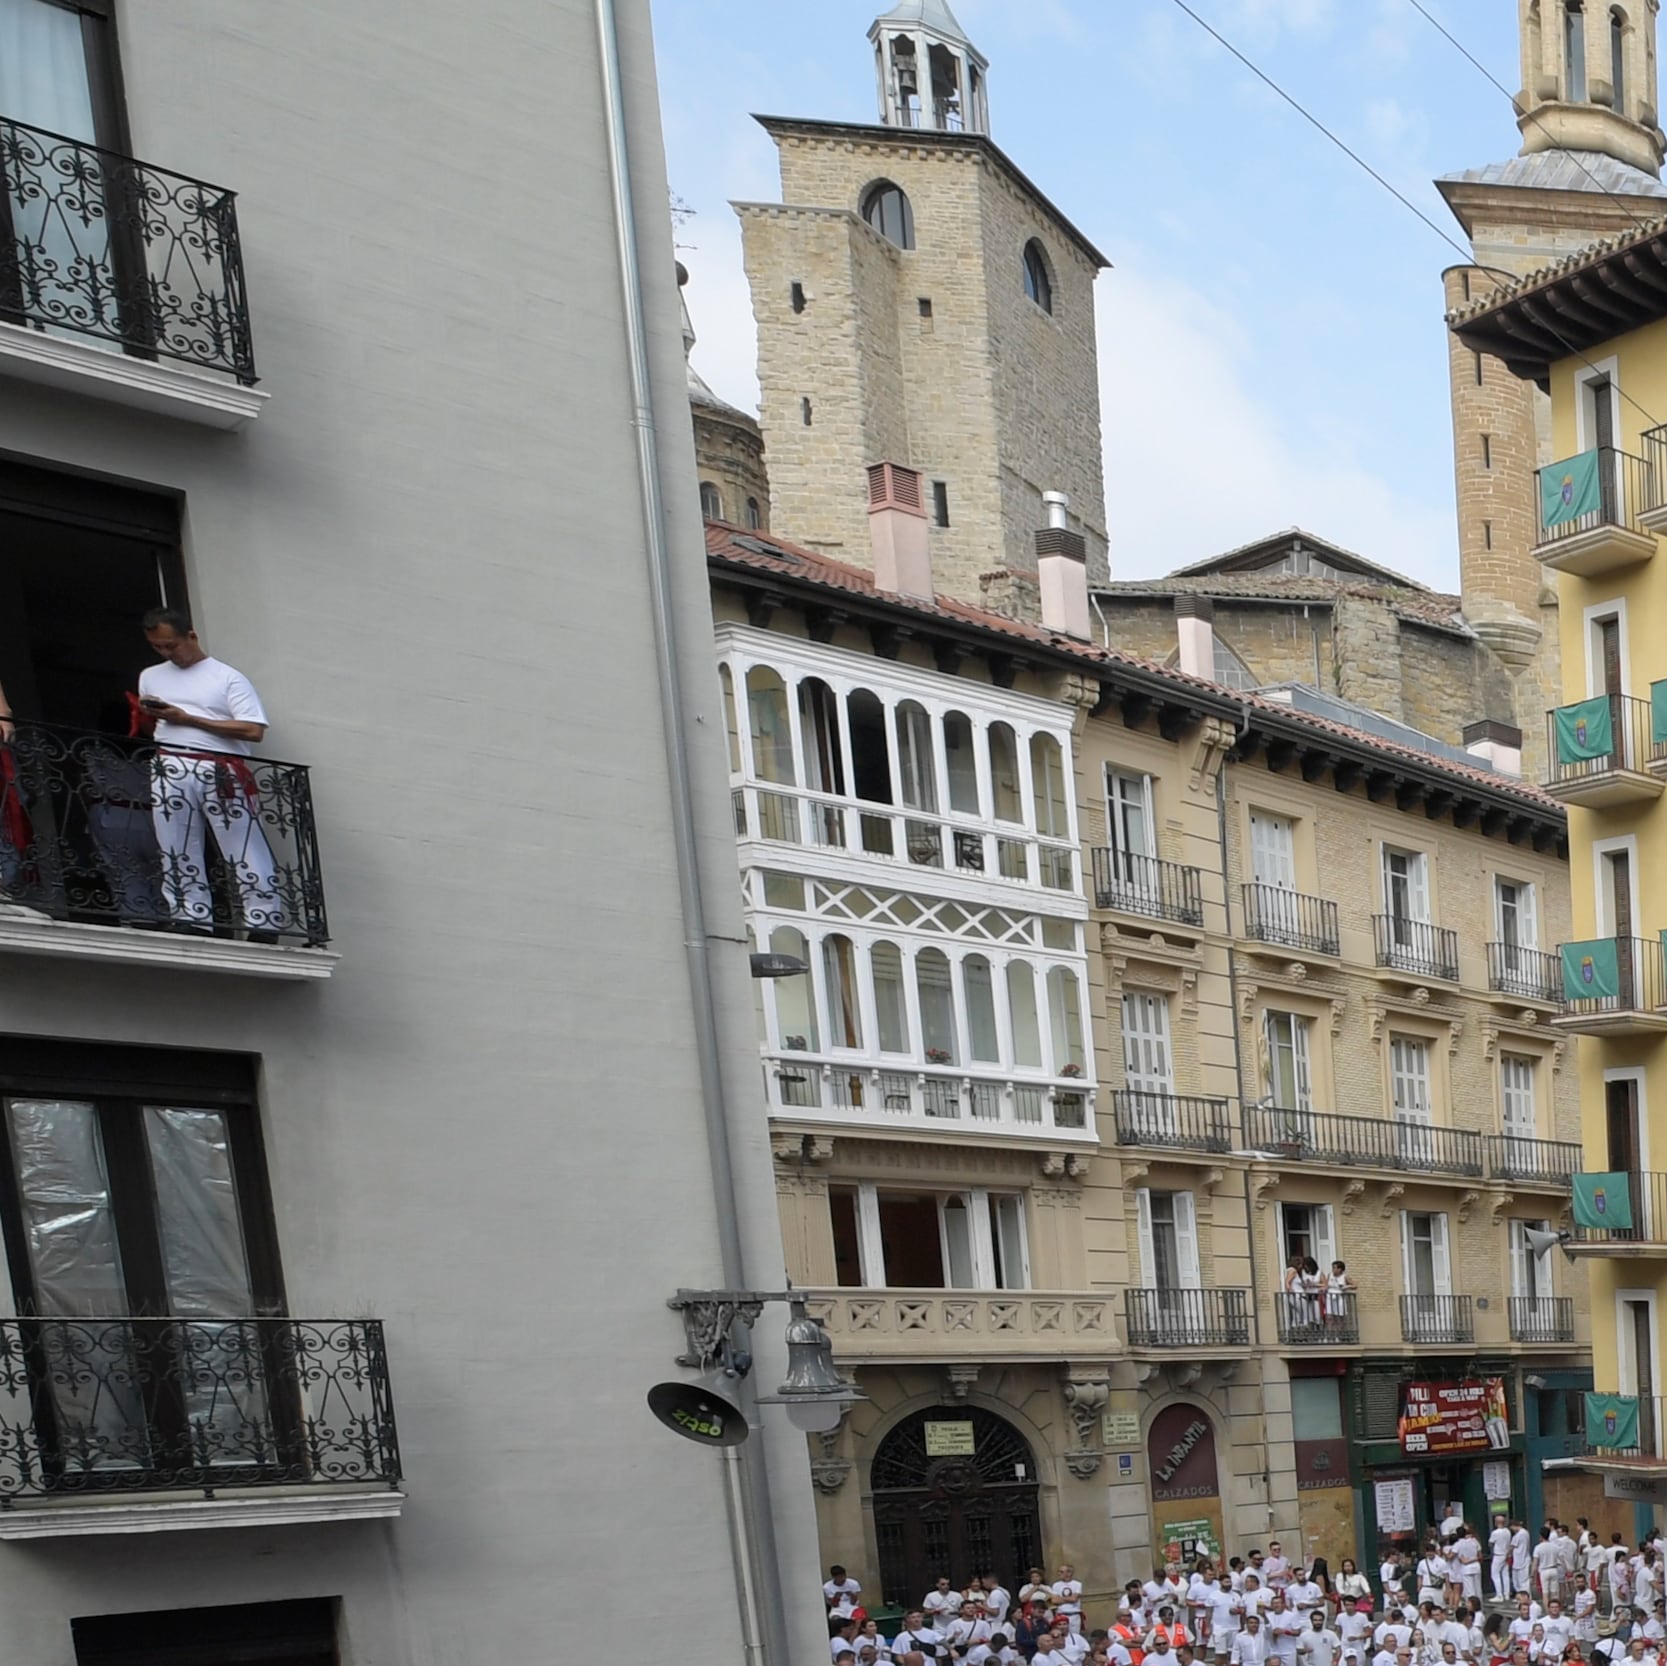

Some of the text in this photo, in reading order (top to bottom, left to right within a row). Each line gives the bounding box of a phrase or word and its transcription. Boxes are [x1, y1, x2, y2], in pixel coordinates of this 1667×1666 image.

[1298, 1477, 1347, 1490] CALZADOS
[1613, 1479, 1657, 1494] WELCOME
[1155, 1485, 1214, 1500] CALZADOS
